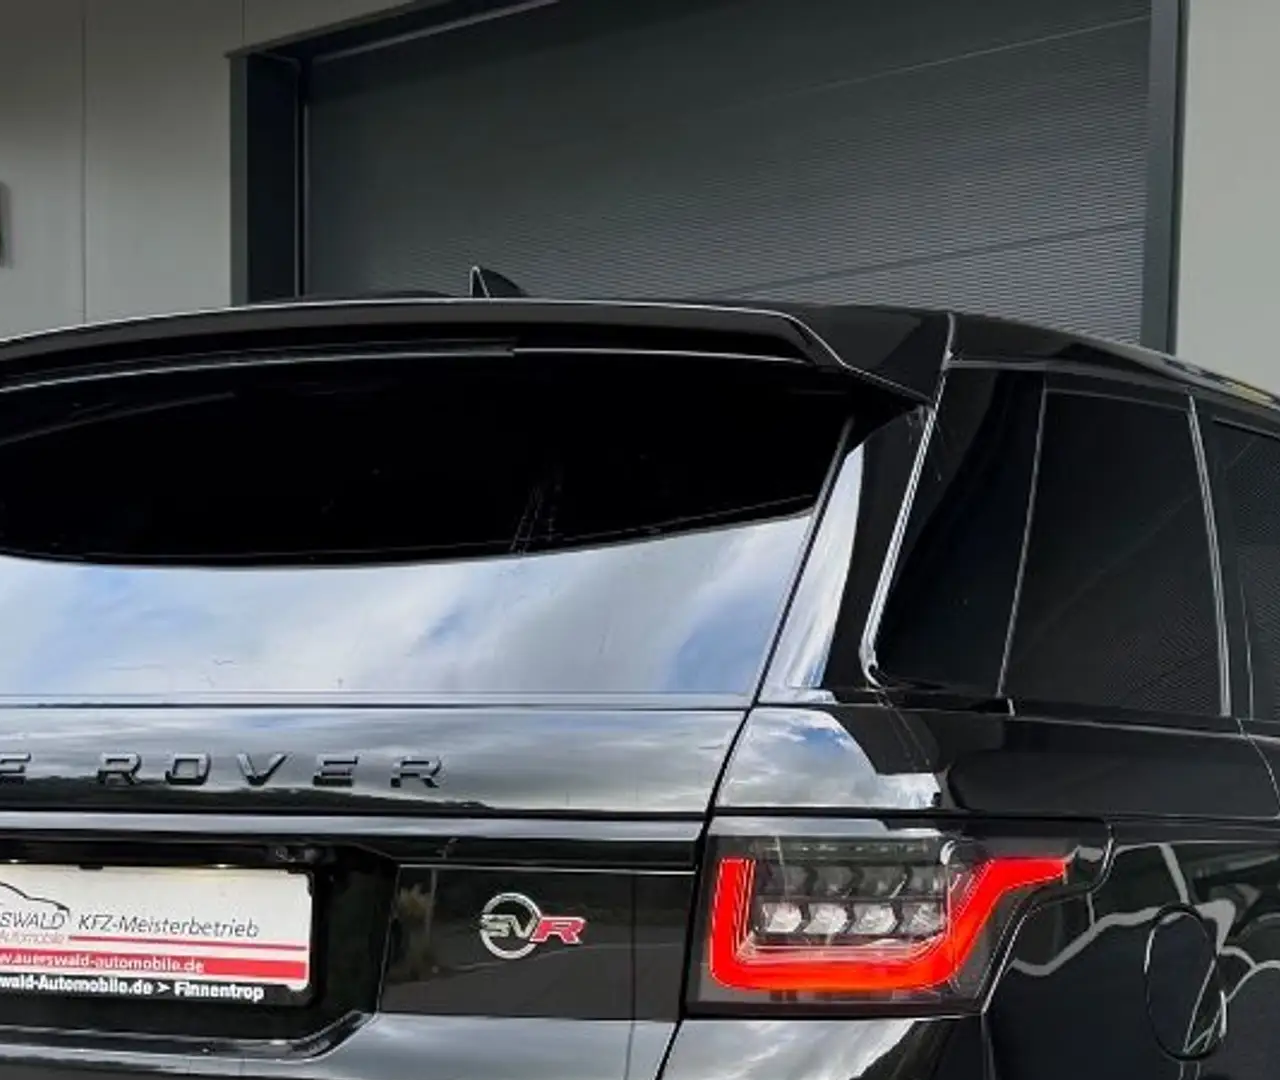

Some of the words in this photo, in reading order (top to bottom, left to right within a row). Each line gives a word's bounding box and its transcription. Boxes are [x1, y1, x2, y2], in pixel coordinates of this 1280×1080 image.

[96, 753, 444, 790] ROVER
[77, 913, 261, 938] KFZ-Meisterbetrieb
[480, 914, 587, 945] SVR
[173, 980, 266, 1003] Finnentrop
